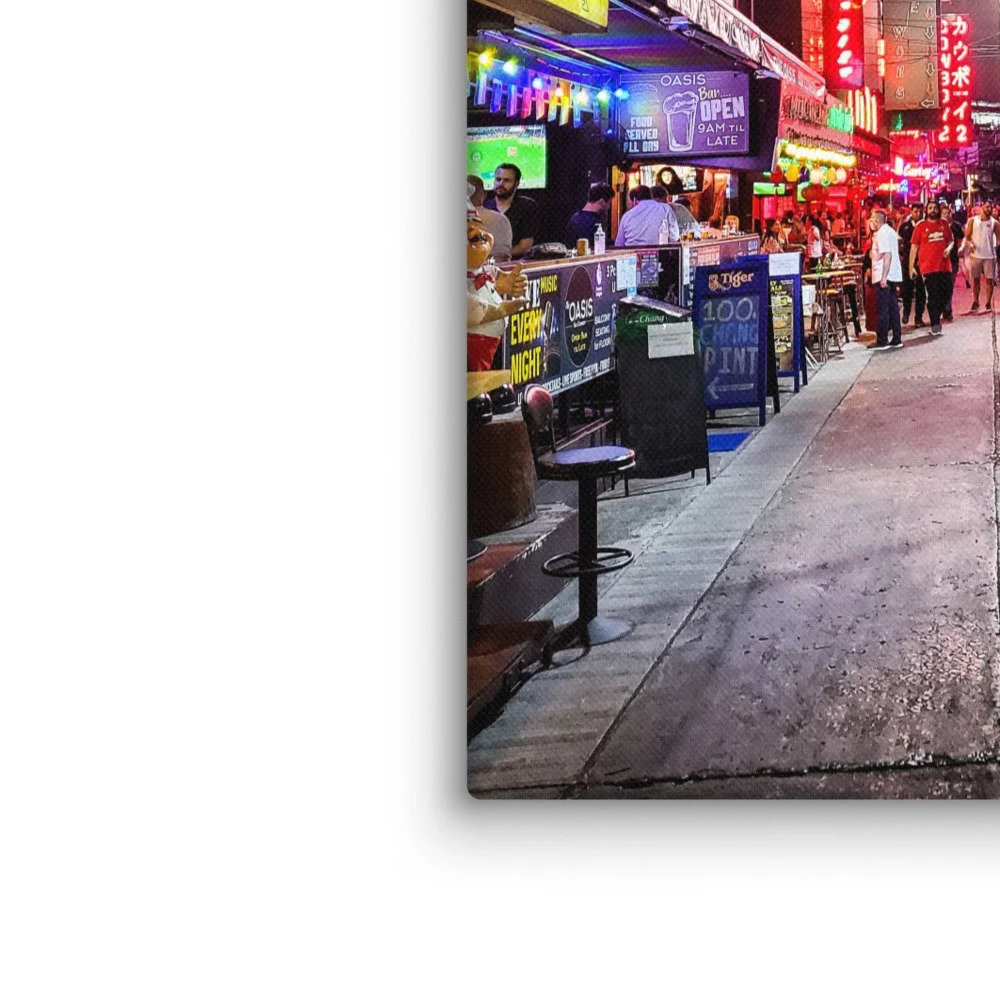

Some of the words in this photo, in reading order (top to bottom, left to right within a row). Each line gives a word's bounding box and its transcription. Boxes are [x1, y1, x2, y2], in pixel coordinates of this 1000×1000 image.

[660, 73, 706, 87] OASIS
[700, 96, 746, 121] OPEN
[630, 116, 653, 128] FOOD
[697, 122, 725, 134] 9AM
[729, 124, 745, 132] TIL
[624, 128, 659, 141] SERVED
[706, 135, 739, 147] LATE
[642, 140, 659, 152] DAY
[540, 275, 558, 294] MUSIC
[721, 271, 754, 288] Tiger
[568, 297, 594, 321] OASIS
[511, 309, 542, 345] EVERY
[510, 346, 542, 385] NIGHT
[704, 346, 759, 375] PINT
